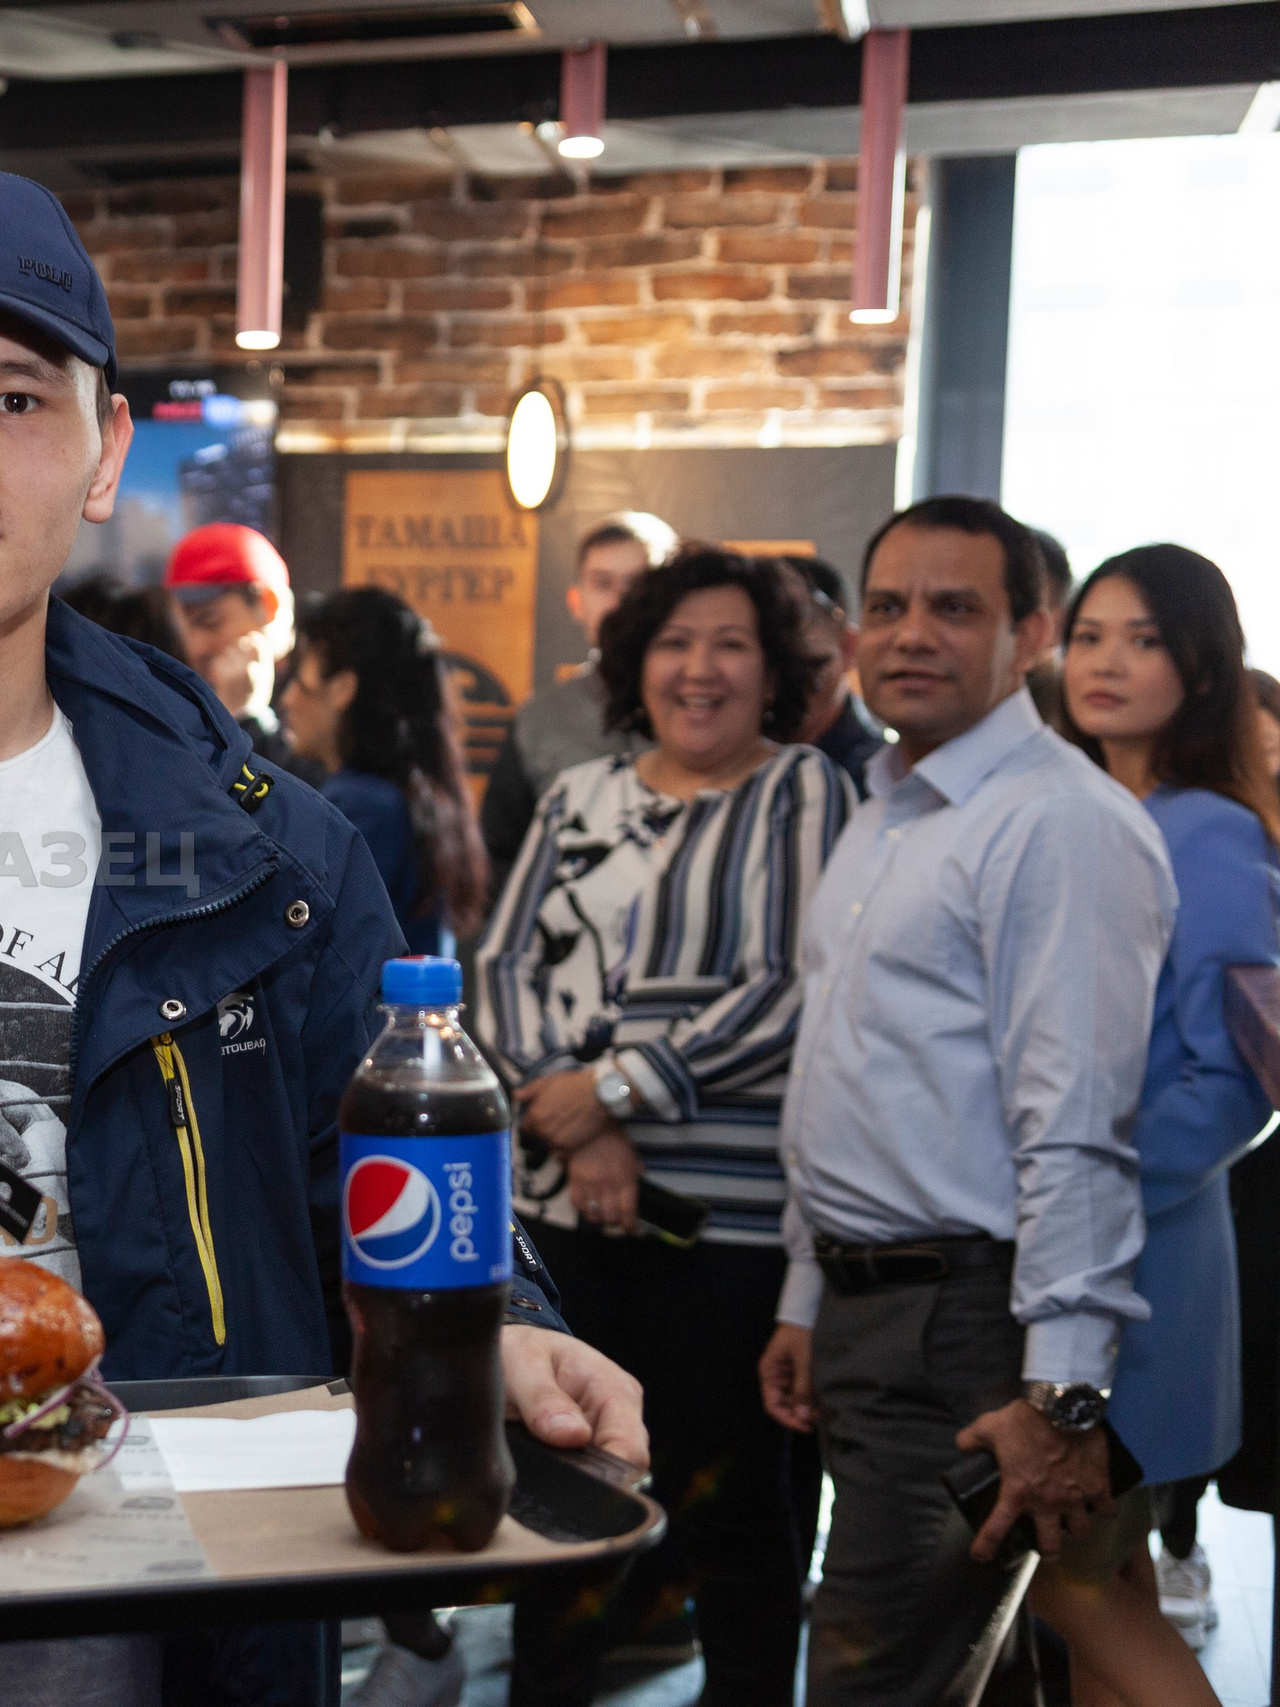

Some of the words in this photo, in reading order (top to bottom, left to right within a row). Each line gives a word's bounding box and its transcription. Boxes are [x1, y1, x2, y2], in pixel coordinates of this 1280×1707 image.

[354, 513, 528, 549] ТАМАША
[174, 1084, 185, 1121] SPORT
[443, 1162, 480, 1262] pepsi
[515, 1235, 537, 1266] SPORT
